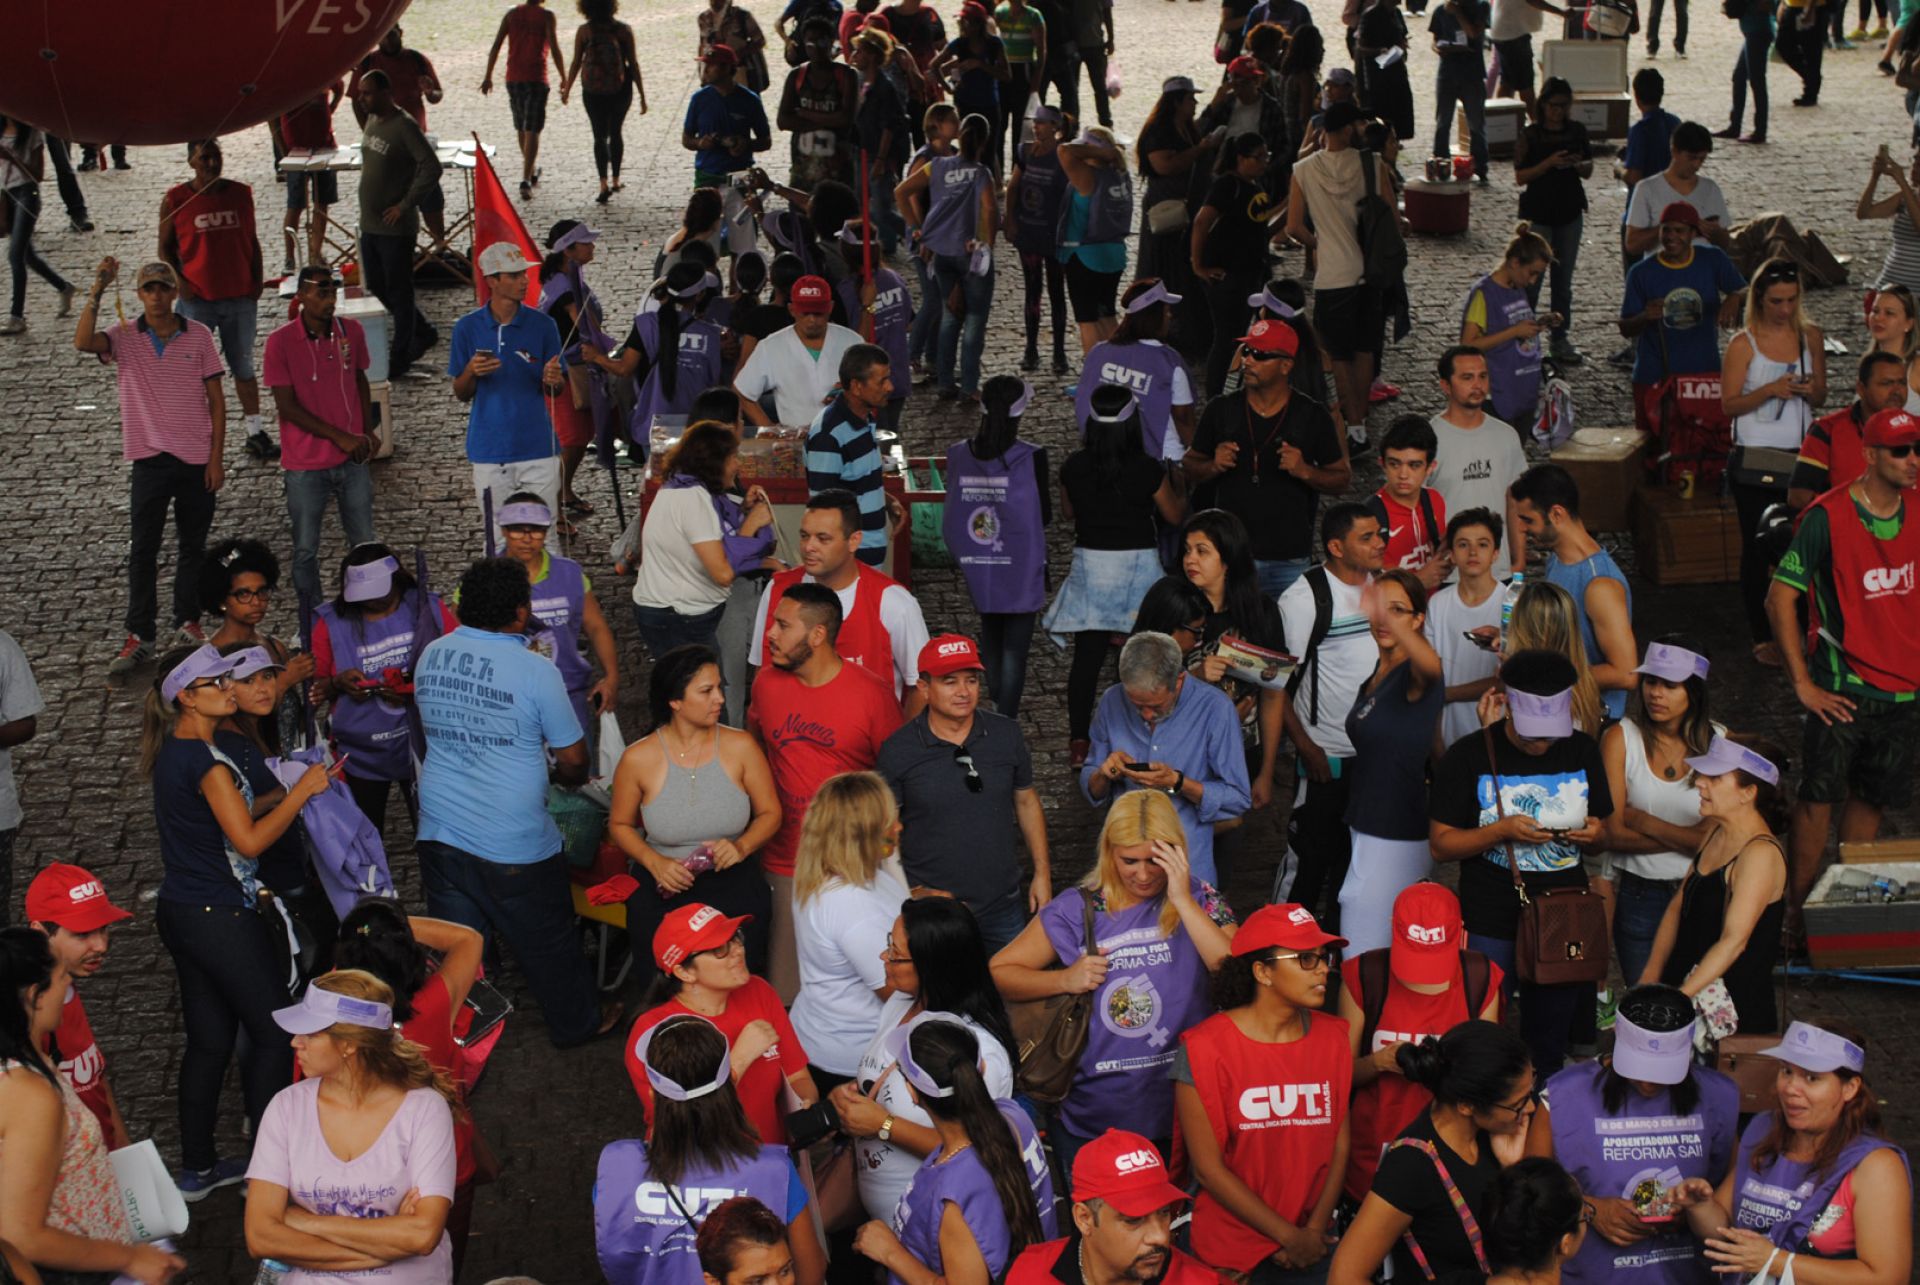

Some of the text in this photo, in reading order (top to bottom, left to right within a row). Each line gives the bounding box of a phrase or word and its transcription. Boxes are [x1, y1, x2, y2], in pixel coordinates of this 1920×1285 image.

[944, 168, 977, 183] CUT
[194, 211, 235, 228] CUT
[1101, 362, 1146, 389] CUT
[1863, 563, 1909, 592] CUT
[938, 641, 966, 654] CUT
[440, 676, 474, 693] ABOUT
[477, 683, 514, 704] DENIM
[69, 881, 100, 899] CUT
[1408, 924, 1441, 942] CUT
[1108, 952, 1172, 972] ORMA SAI!
[1095, 1060, 1118, 1071] CUT
[1239, 1084, 1321, 1120] CUT
[1625, 1120, 1658, 1130] MARÇO
[1603, 1134, 1700, 1147] APOSENTADORIA FICA
[1603, 1146, 1675, 1160] REFORMA
[635, 1181, 735, 1217] CUT
